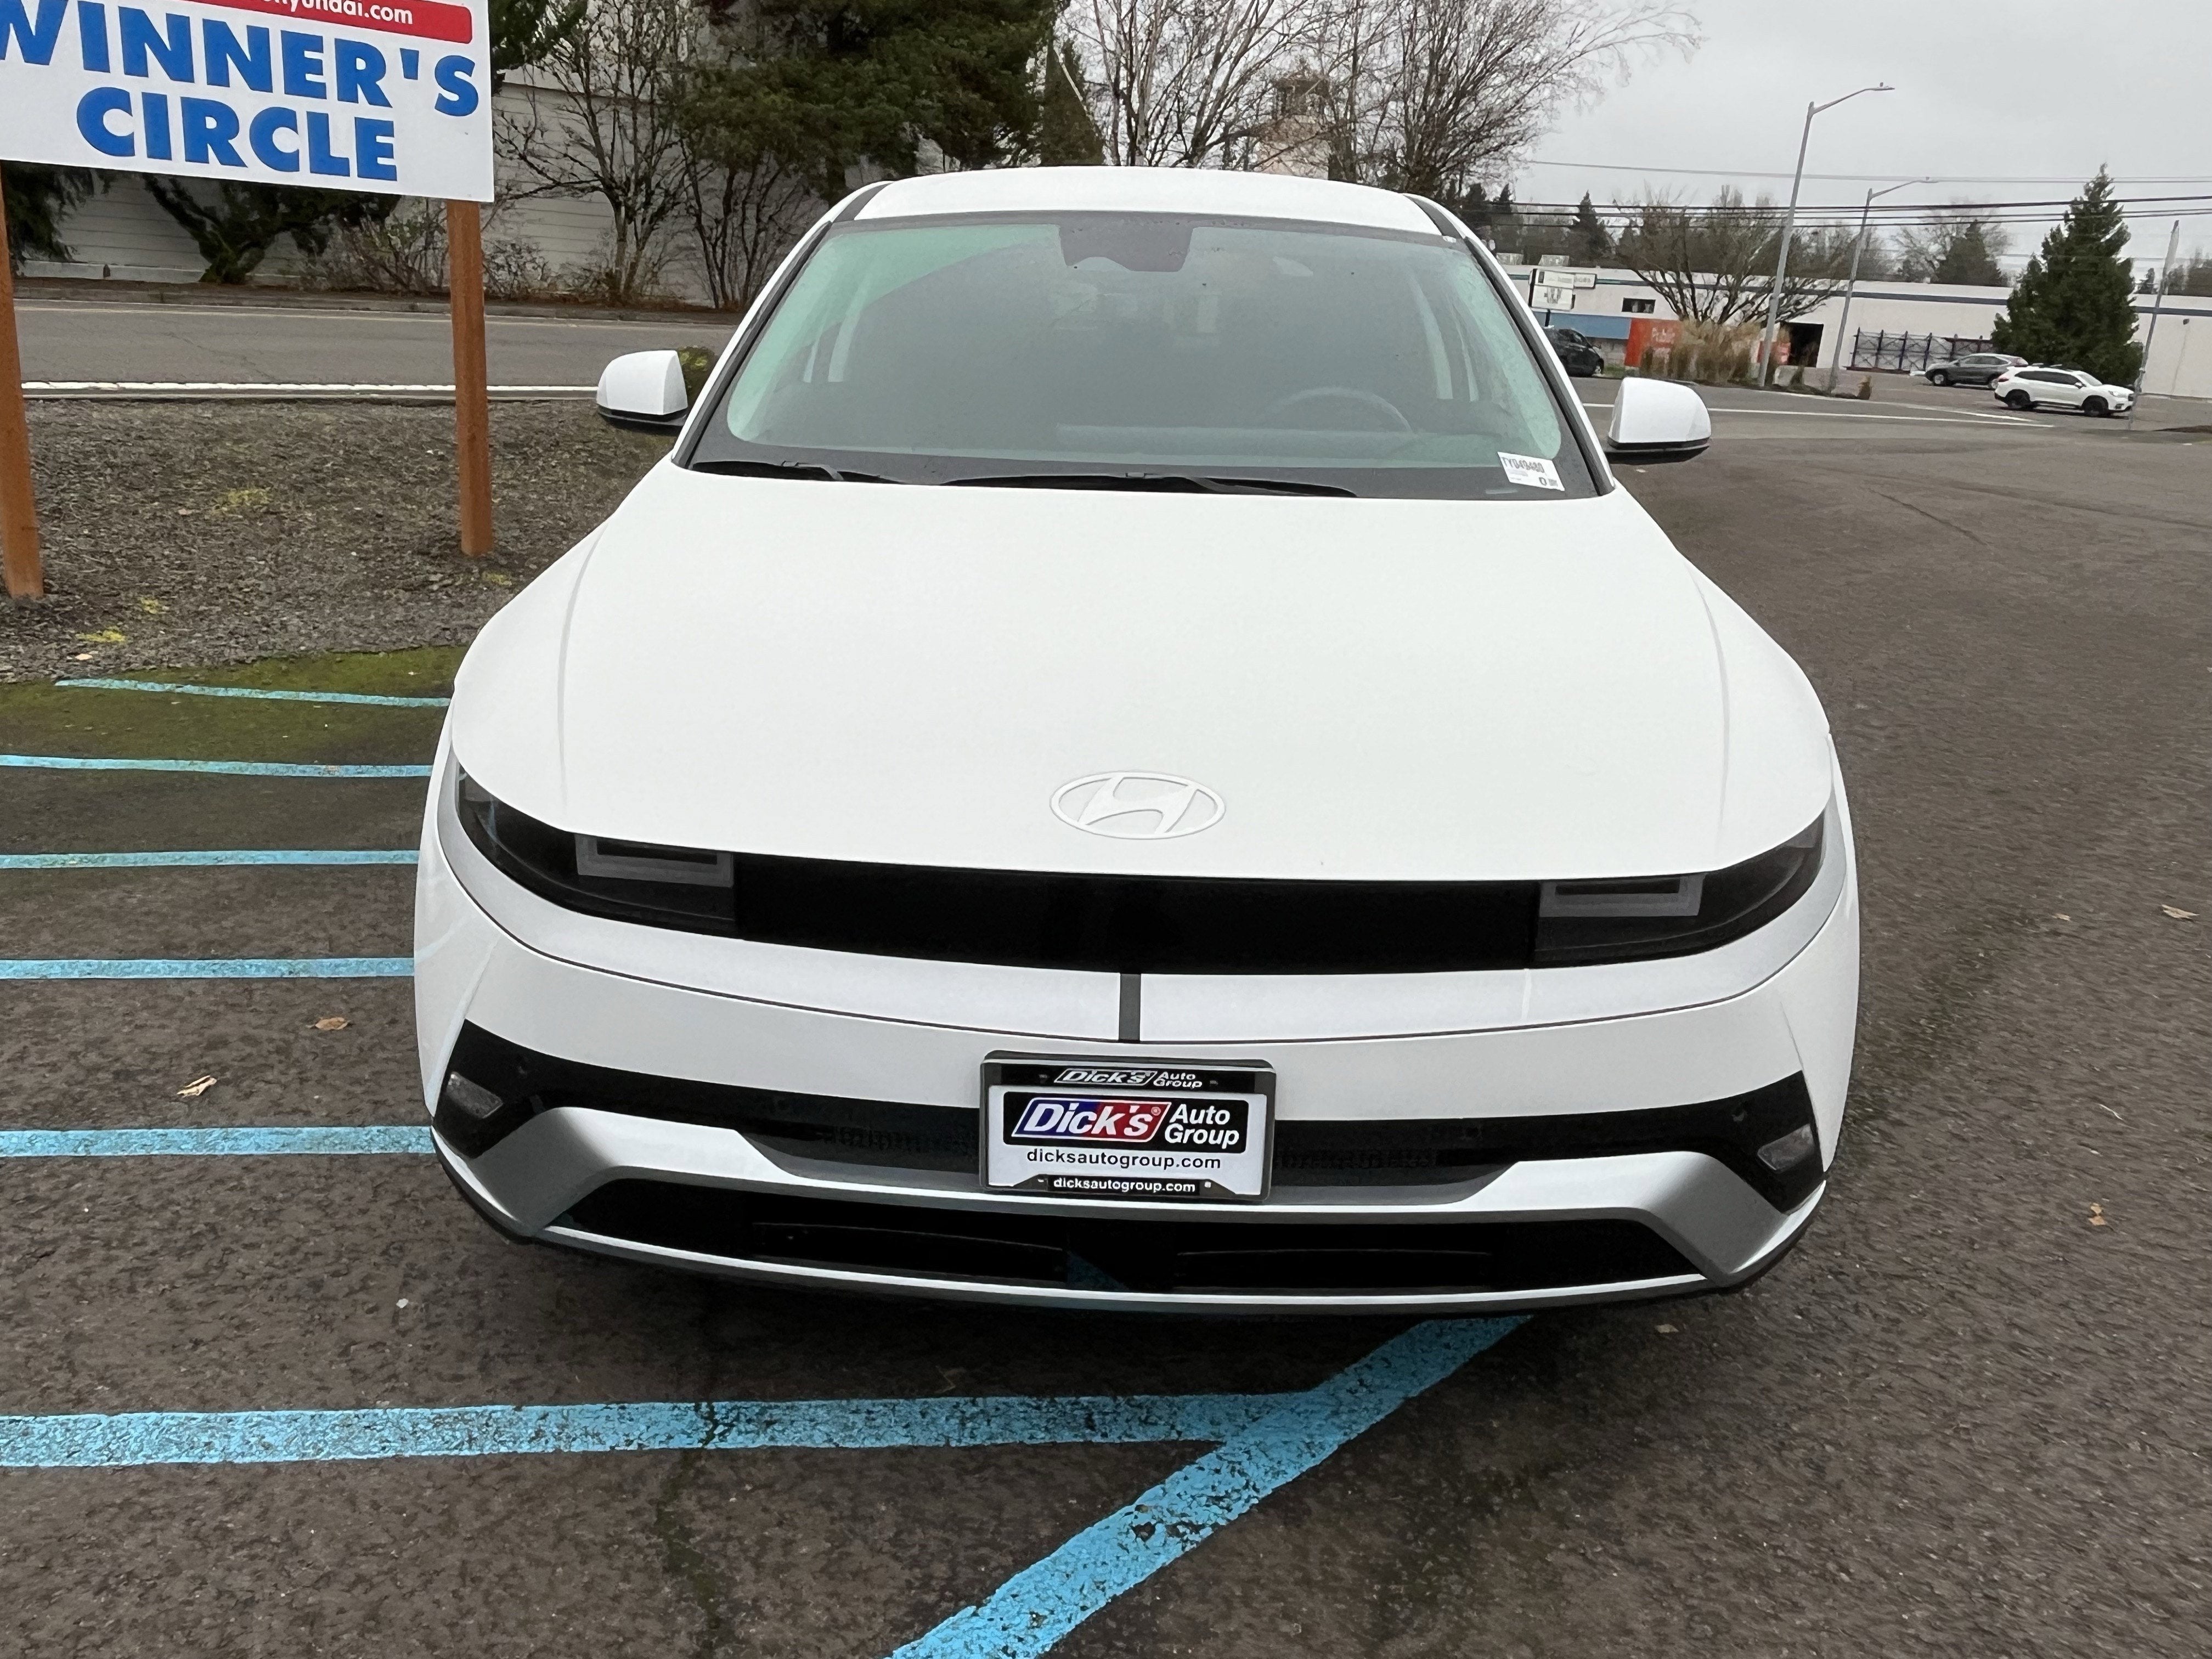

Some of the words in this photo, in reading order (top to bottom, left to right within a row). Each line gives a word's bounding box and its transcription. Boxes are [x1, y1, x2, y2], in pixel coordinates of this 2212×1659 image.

[264, 0, 413, 24] yundai.com
[0, 0, 478, 117] WINNER'S
[76, 86, 397, 182] CIRCLE
[1153, 1078, 1203, 1089] Group
[1158, 1071, 1196, 1080] Auto
[1024, 1102, 1153, 1136] Dick's
[1169, 1104, 1231, 1125] Auto
[1164, 1124, 1240, 1149] Group
[1027, 1148, 1221, 1170] dicksautogroup.com
[1053, 1177, 1195, 1193] dicksautogroup.com
